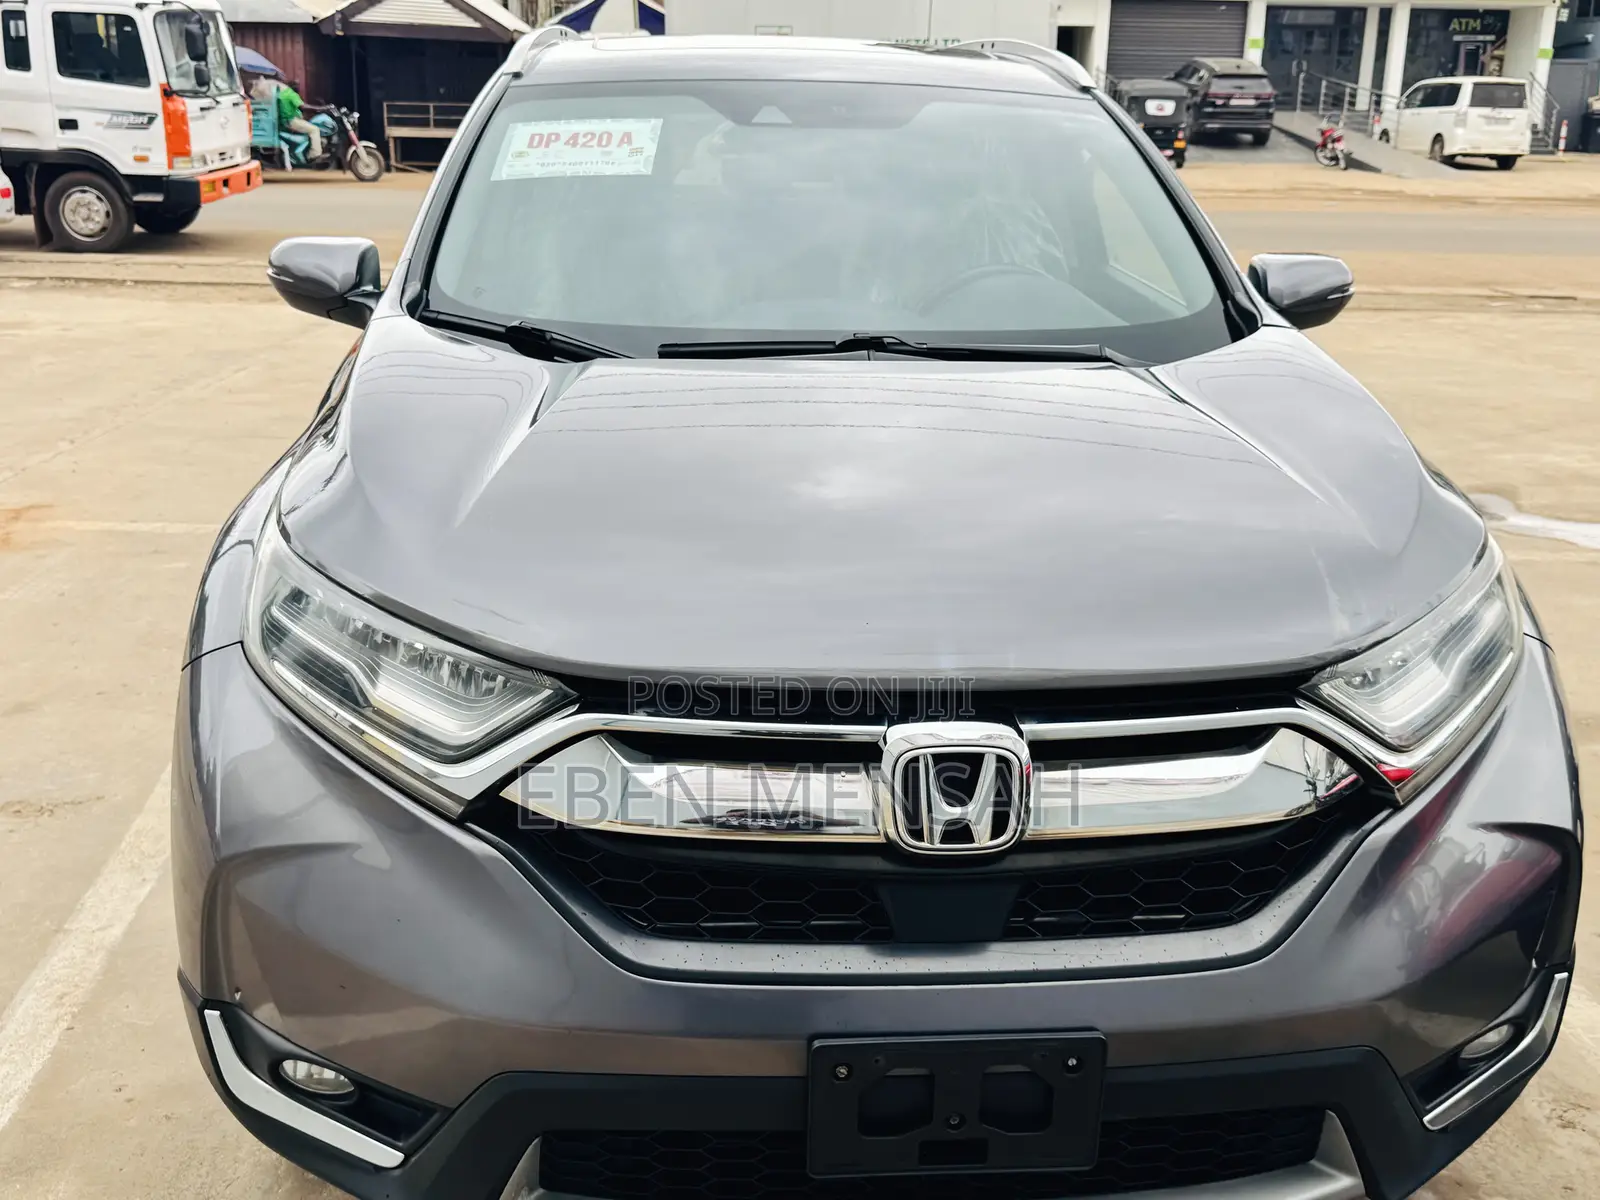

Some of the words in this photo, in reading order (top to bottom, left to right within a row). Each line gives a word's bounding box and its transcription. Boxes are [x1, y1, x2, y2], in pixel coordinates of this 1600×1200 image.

[1449, 18, 1480, 31] ATM
[527, 133, 561, 149] DP
[563, 131, 614, 149] 420
[617, 131, 633, 148] A
